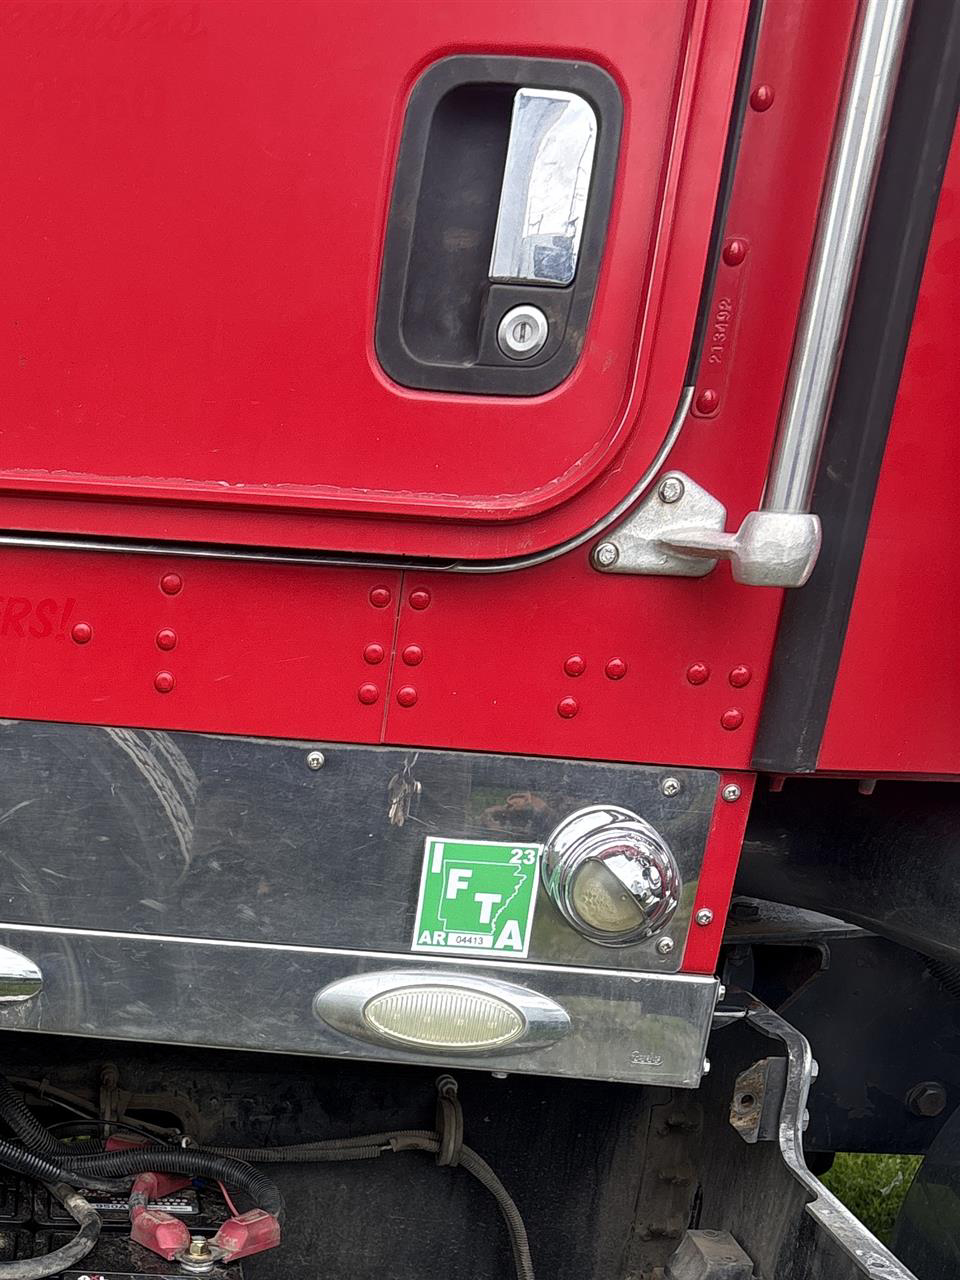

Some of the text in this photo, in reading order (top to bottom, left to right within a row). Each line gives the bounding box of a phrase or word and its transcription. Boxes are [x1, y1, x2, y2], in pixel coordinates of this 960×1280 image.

[707, 296, 733, 364] 213492
[509, 848, 536, 864] 23
[418, 930, 484, 945] AR 04413
